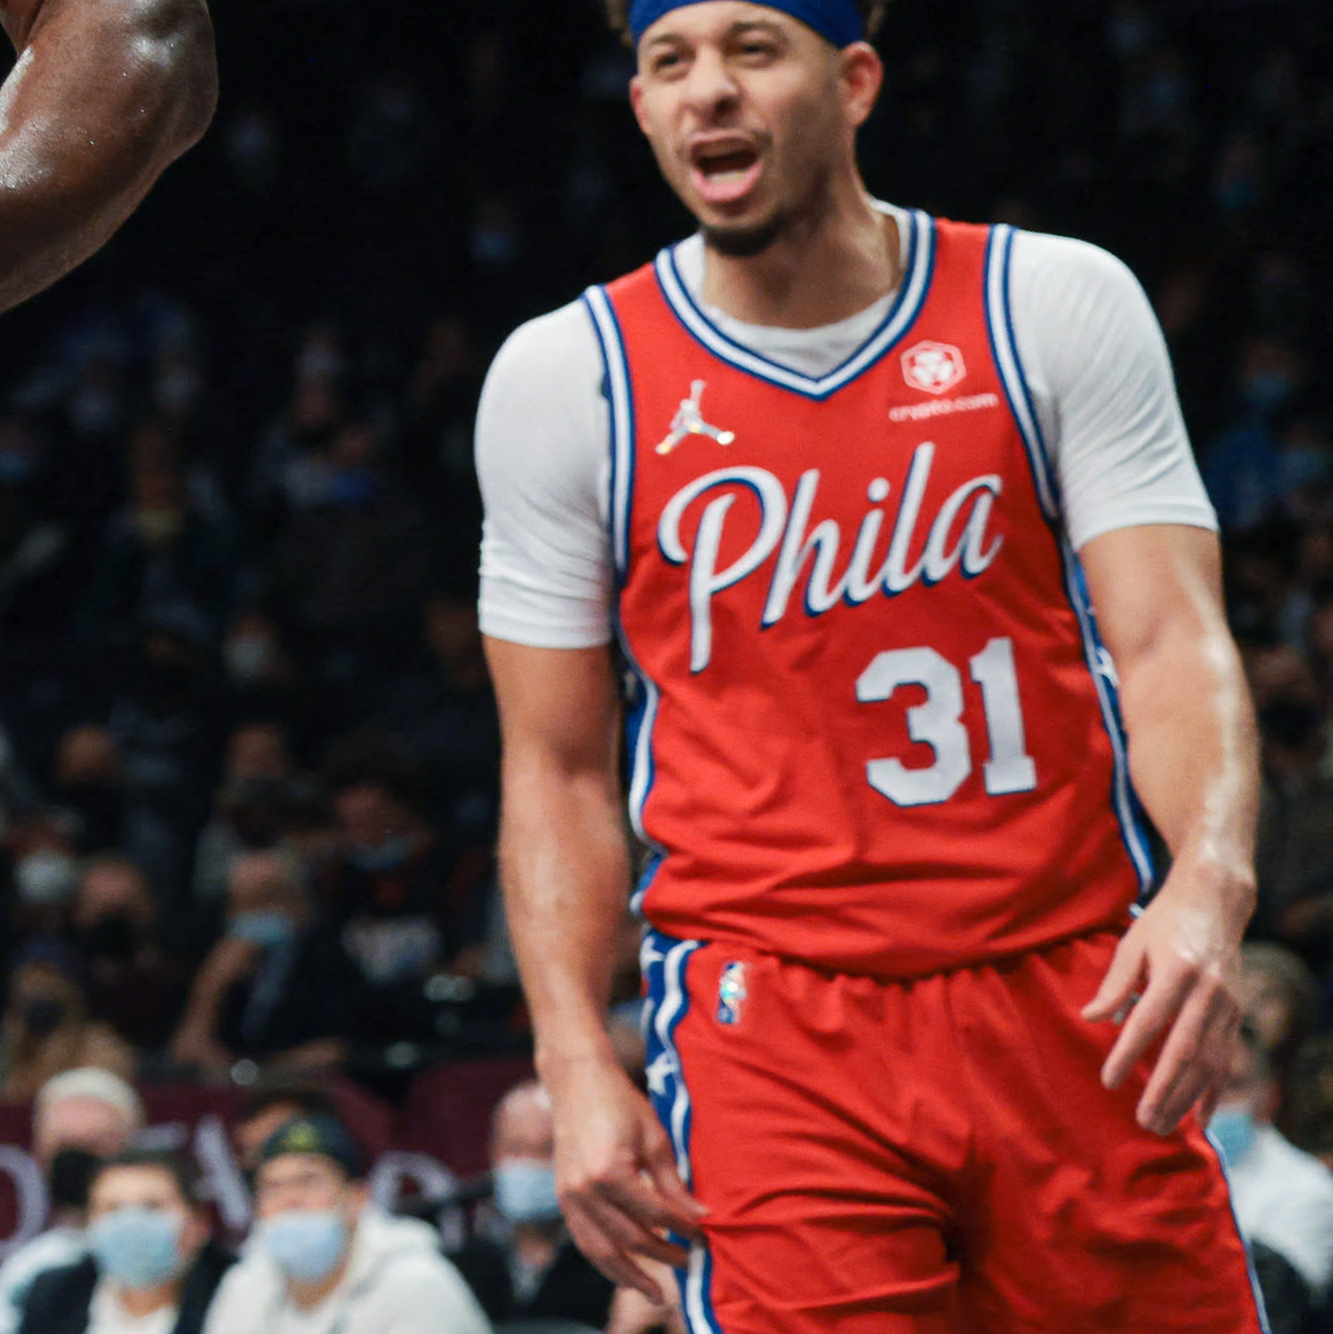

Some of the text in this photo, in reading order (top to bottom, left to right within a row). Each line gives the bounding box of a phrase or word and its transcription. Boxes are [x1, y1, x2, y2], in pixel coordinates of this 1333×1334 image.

[888, 393, 1000, 422] crypto.com
[657, 442, 1003, 675] Phila
[855, 636, 1036, 807] 31
